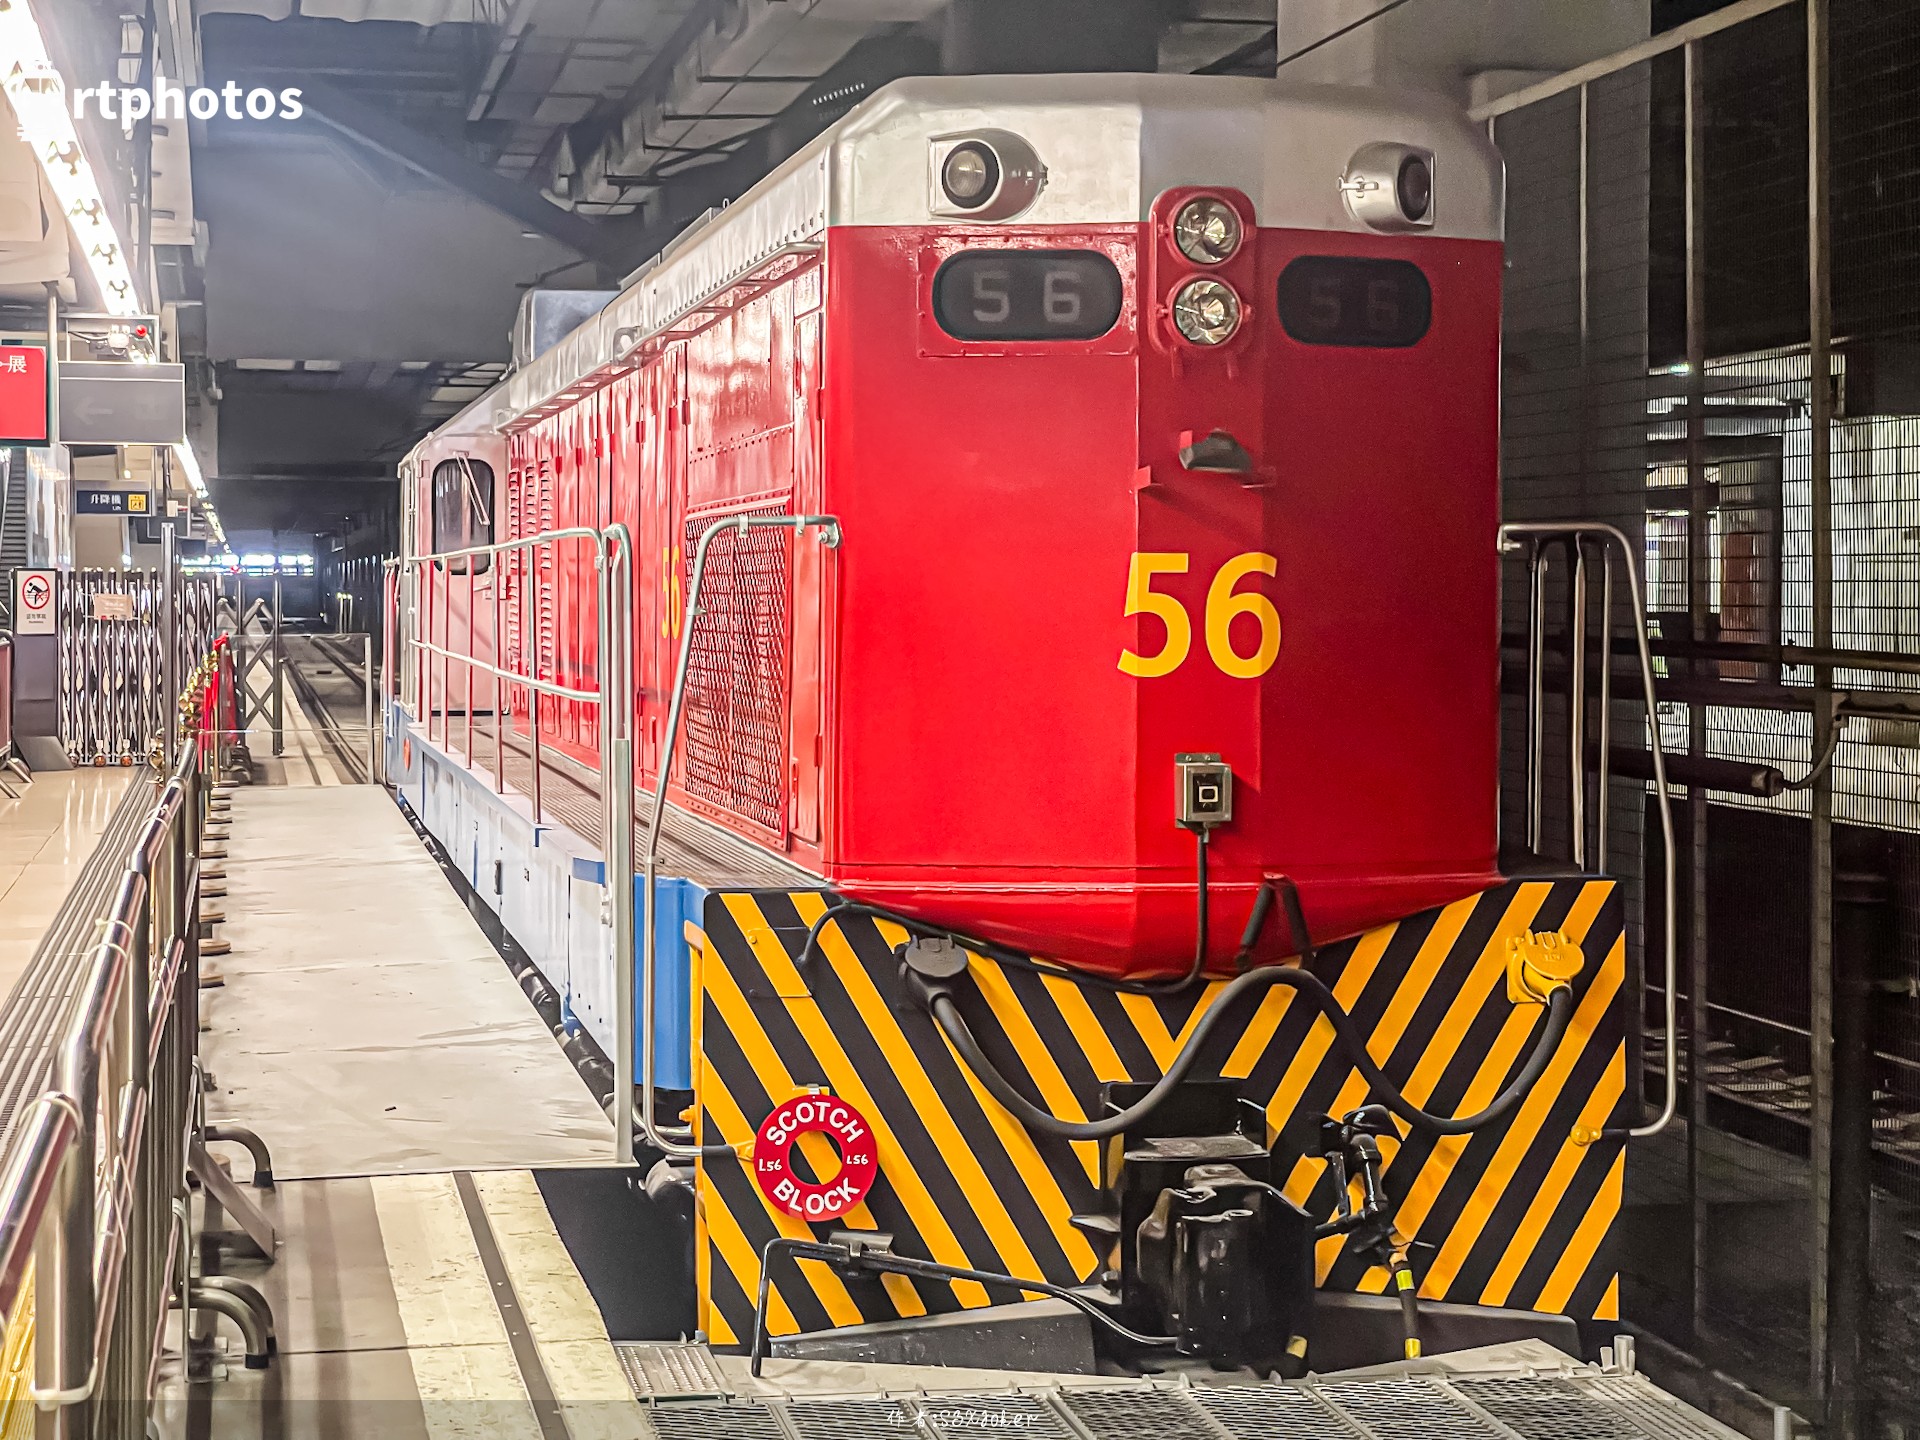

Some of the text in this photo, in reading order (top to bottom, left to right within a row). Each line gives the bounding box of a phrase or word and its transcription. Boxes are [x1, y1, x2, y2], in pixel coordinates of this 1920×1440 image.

[973, 271, 1083, 323] 56
[661, 545, 681, 640] 56
[1117, 552, 1281, 679] 56
[766, 1101, 864, 1146] SCOTCH
[758, 1158, 783, 1172] L56
[846, 1153, 869, 1166] L56
[773, 1177, 861, 1215] BLOCK
